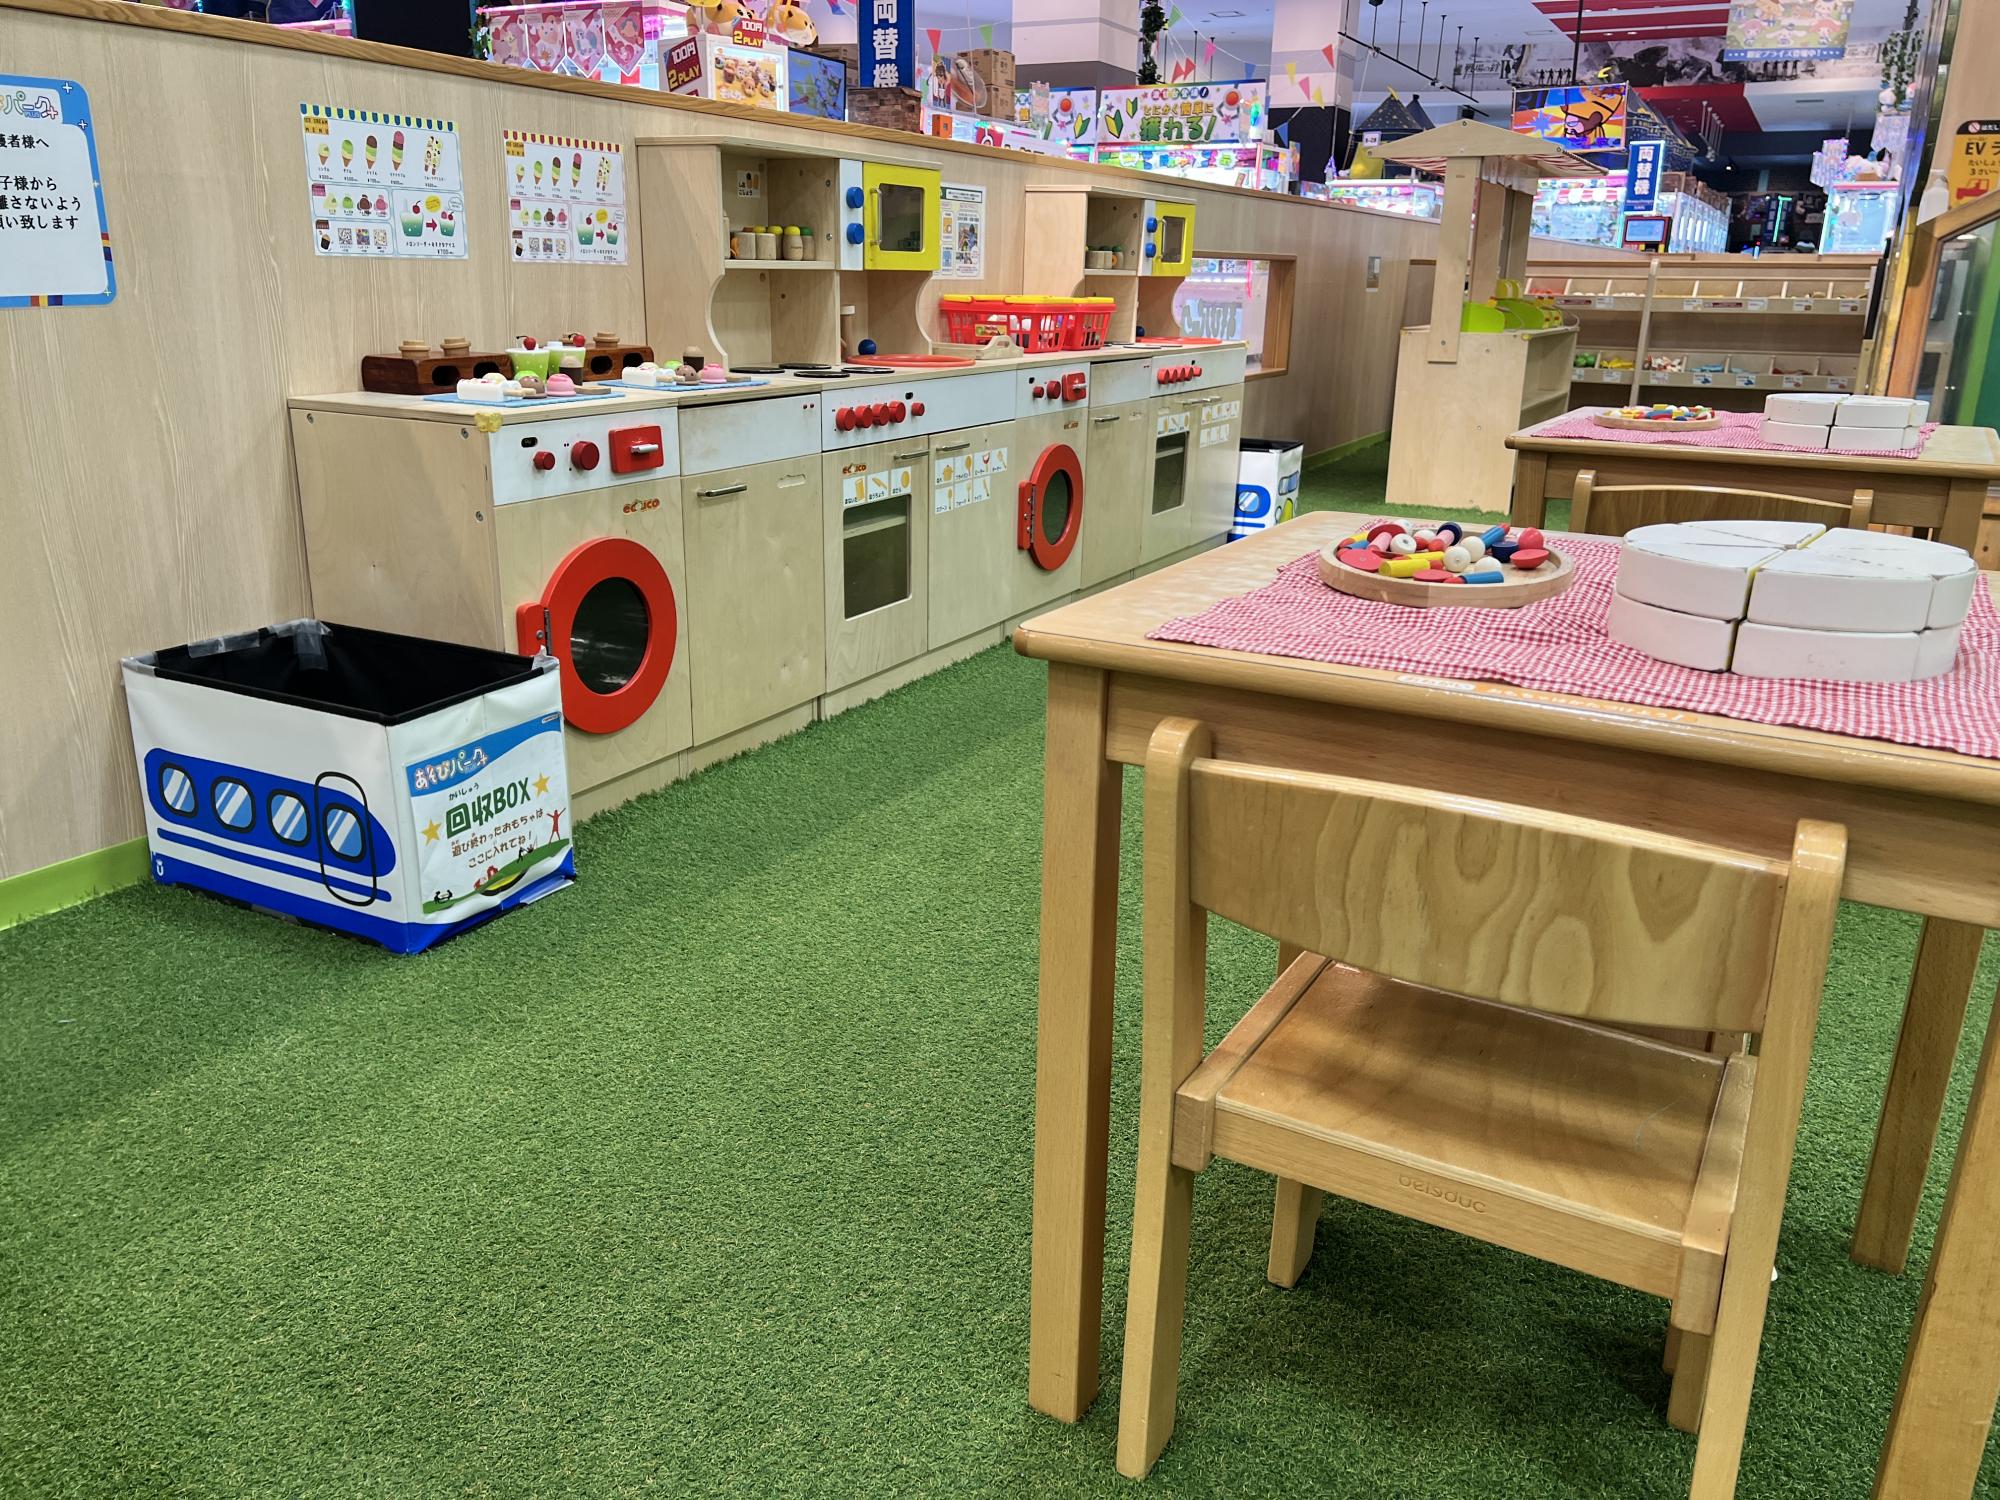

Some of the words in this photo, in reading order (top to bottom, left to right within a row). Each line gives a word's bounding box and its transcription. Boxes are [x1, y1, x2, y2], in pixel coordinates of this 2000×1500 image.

[741, 19, 763, 32] 100円
[671, 41, 696, 65] 100円
[1143, 101, 1214, 116] とにかく簡単に
[1965, 142, 1987, 155] EV
[0, 175, 57, 191] 子様から
[0, 215, 79, 230] い致します
[449, 783, 479, 801] かいしゅう
[446, 777, 531, 839] 回収BOX
[452, 808, 544, 857] 遊び終わったおもちゃは
[469, 831, 532, 868] ここに入れてね!
